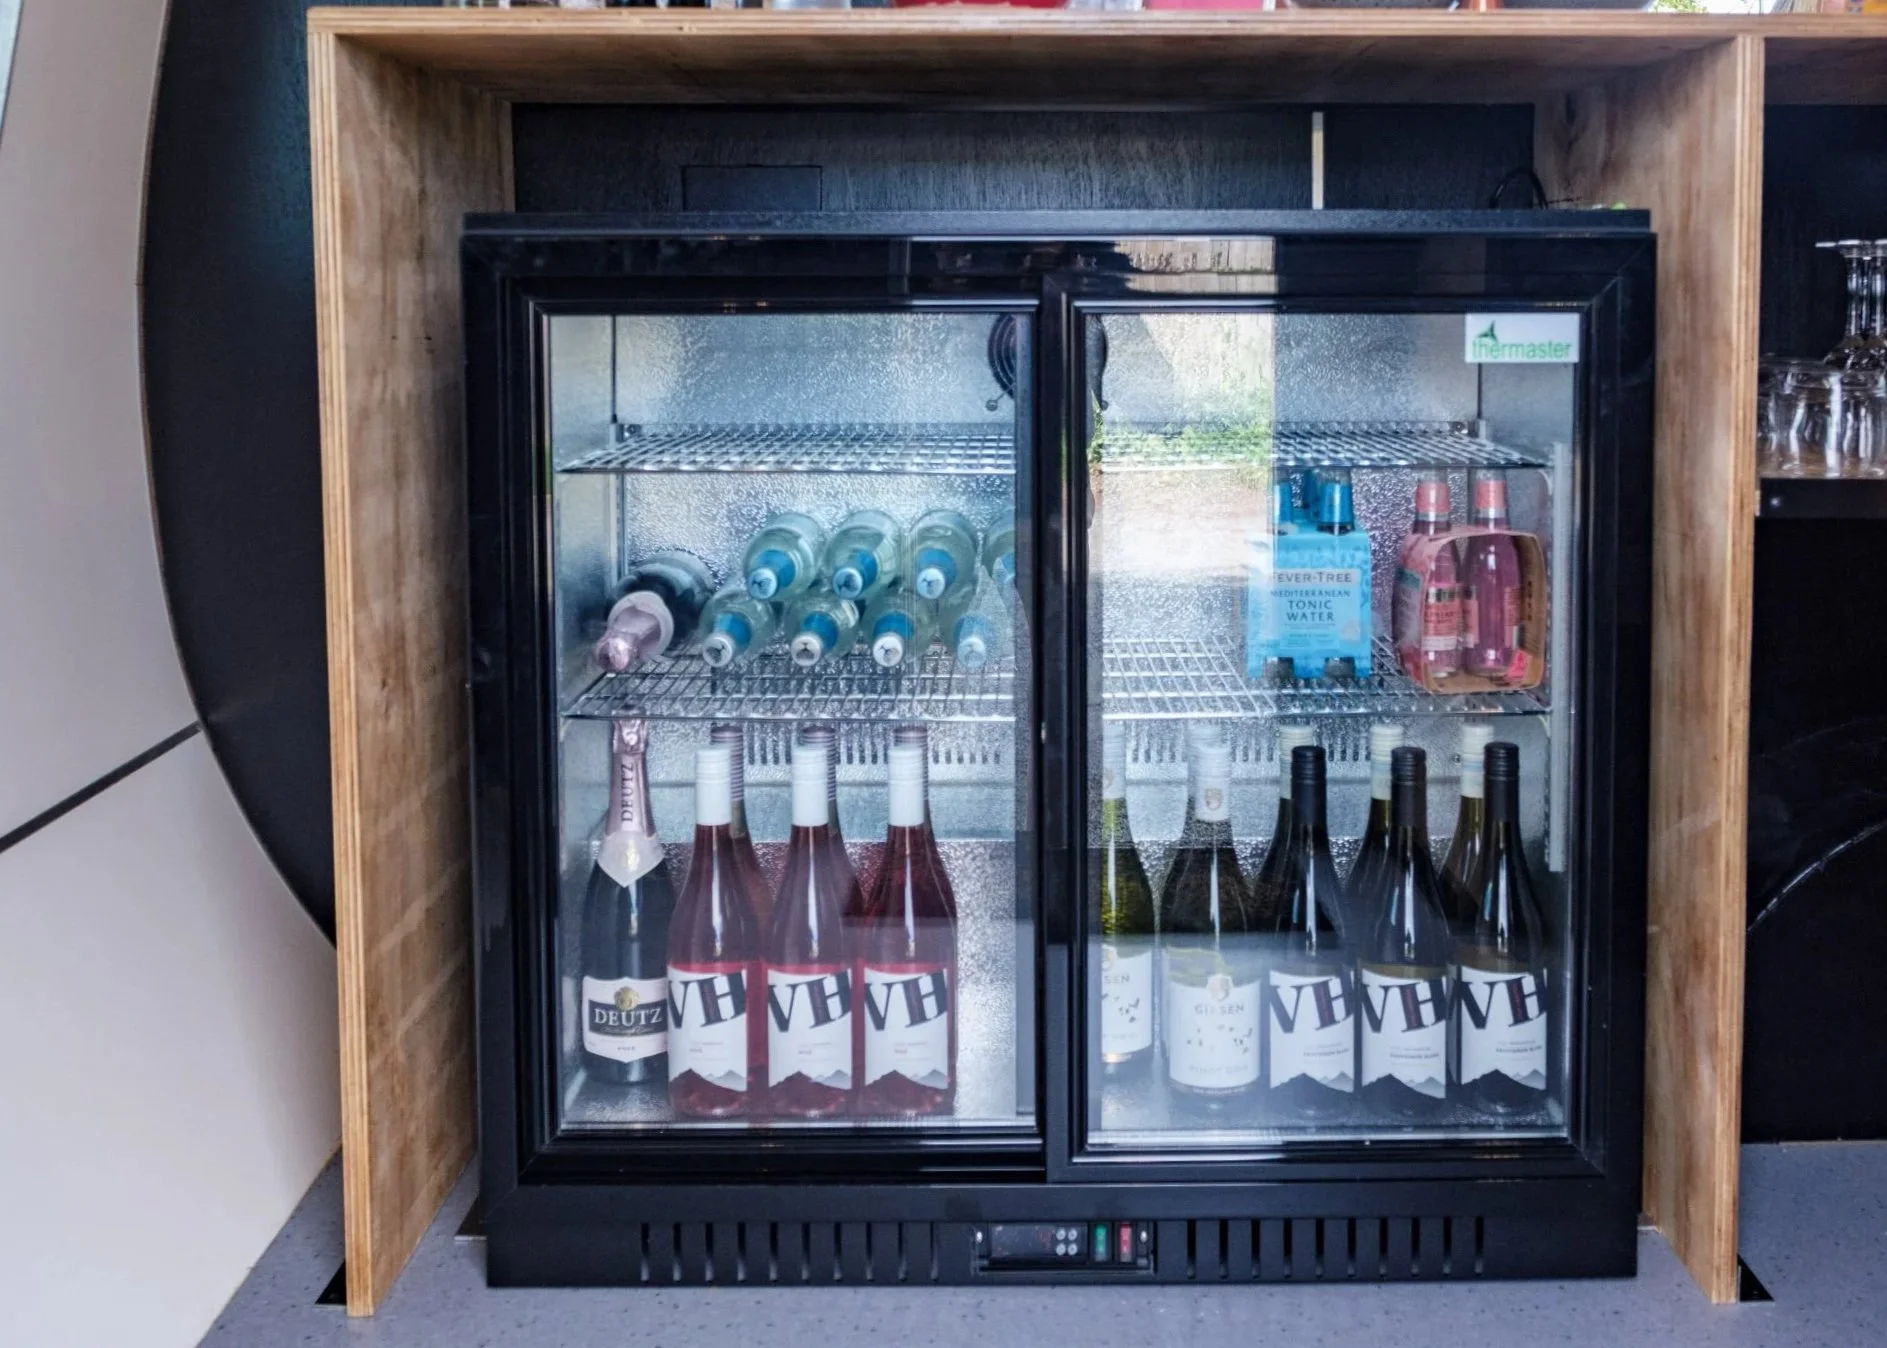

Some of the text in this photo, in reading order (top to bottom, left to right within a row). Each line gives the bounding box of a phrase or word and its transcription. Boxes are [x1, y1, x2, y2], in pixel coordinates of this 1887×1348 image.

[1472, 339, 1572, 359] thermaster
[1286, 612, 1335, 622] WATER
[1288, 600, 1333, 610] TONIC
[620, 763, 634, 822] DEUTZ
[594, 1007, 663, 1027] DEUTZ
[668, 971, 747, 1030] VH
[767, 971, 852, 1033] VH
[863, 971, 948, 1032] VH
[1269, 969, 1355, 1034] VH
[1361, 976, 1446, 1034] VH
[1461, 970, 1547, 1030] VH
